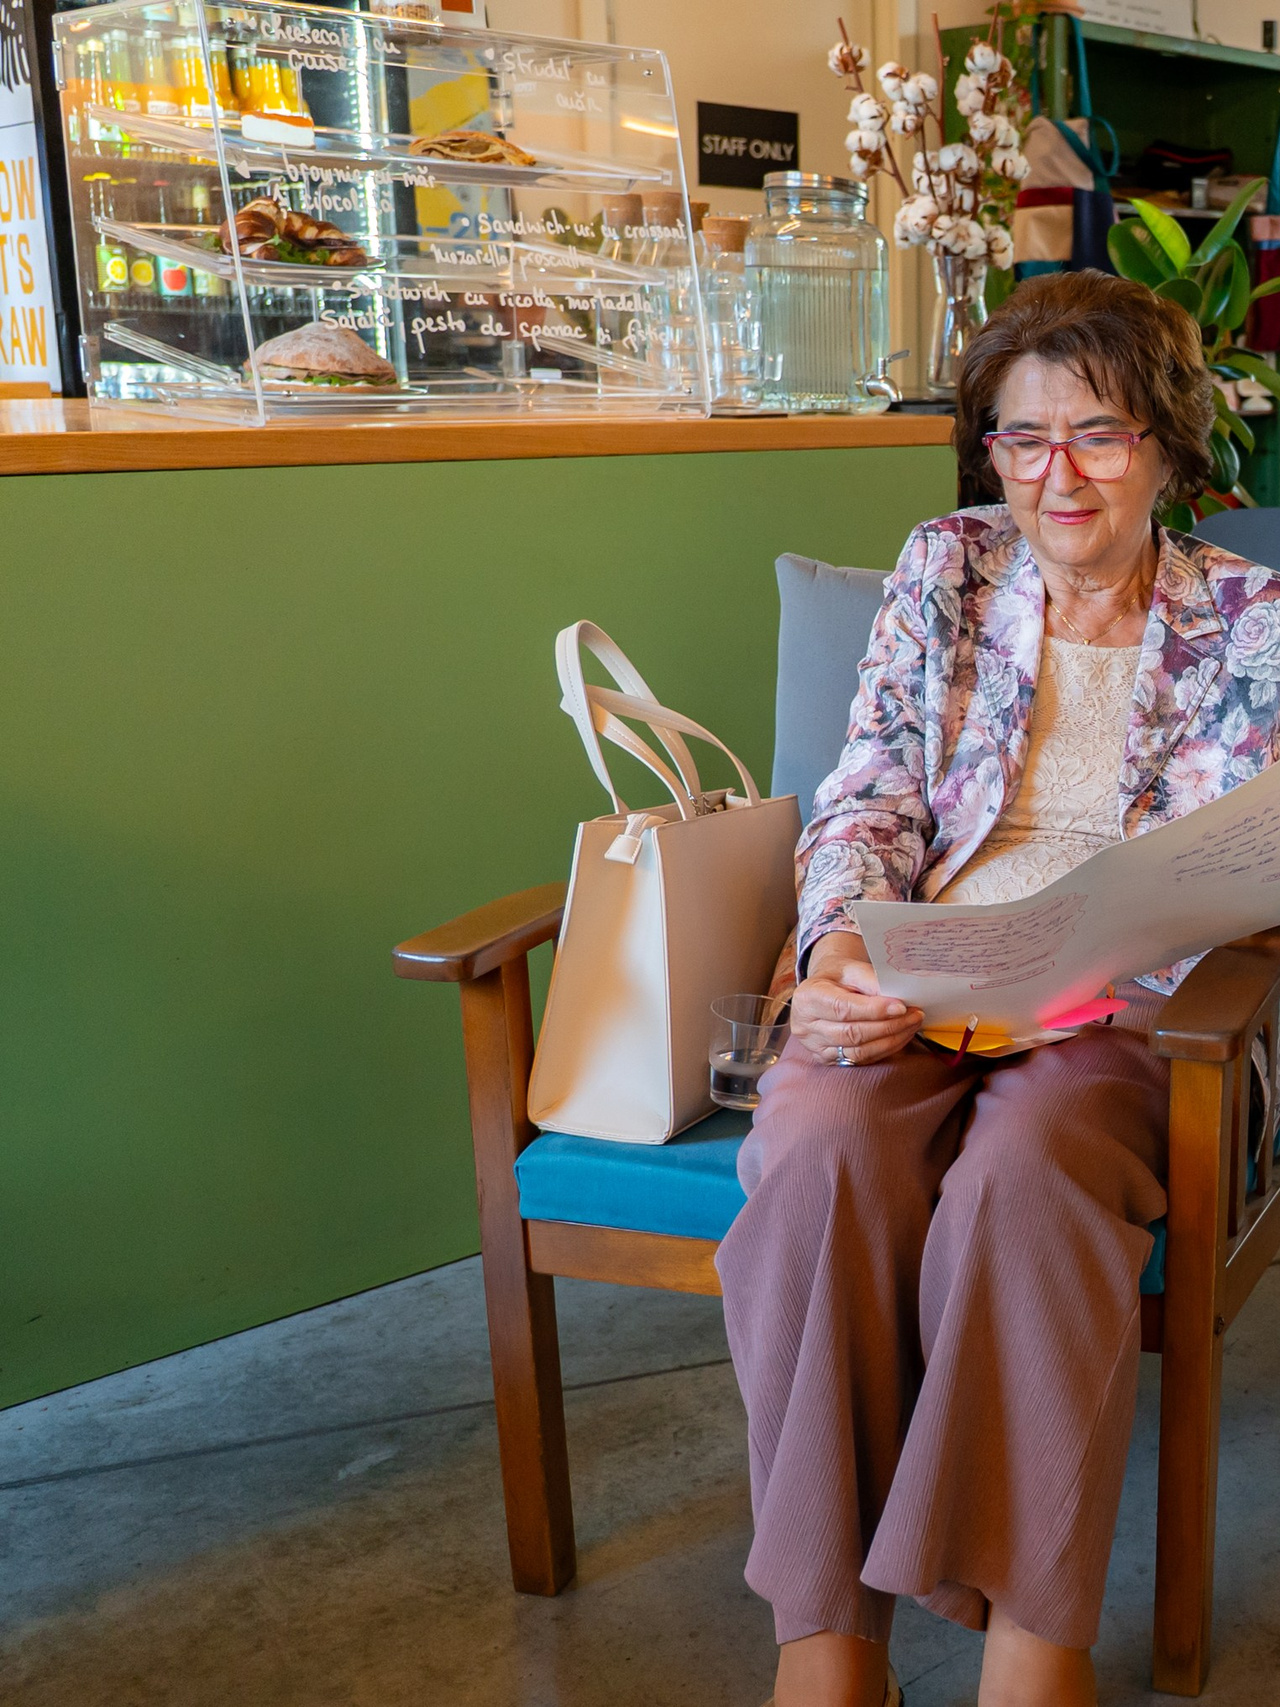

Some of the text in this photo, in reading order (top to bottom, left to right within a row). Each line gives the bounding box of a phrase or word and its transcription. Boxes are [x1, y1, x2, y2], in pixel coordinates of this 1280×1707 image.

[702, 134, 795, 162] STAFF ONLY
[464, 292, 489, 305] cu
[411, 310, 466, 354] pesto
[481, 315, 511, 336] de
